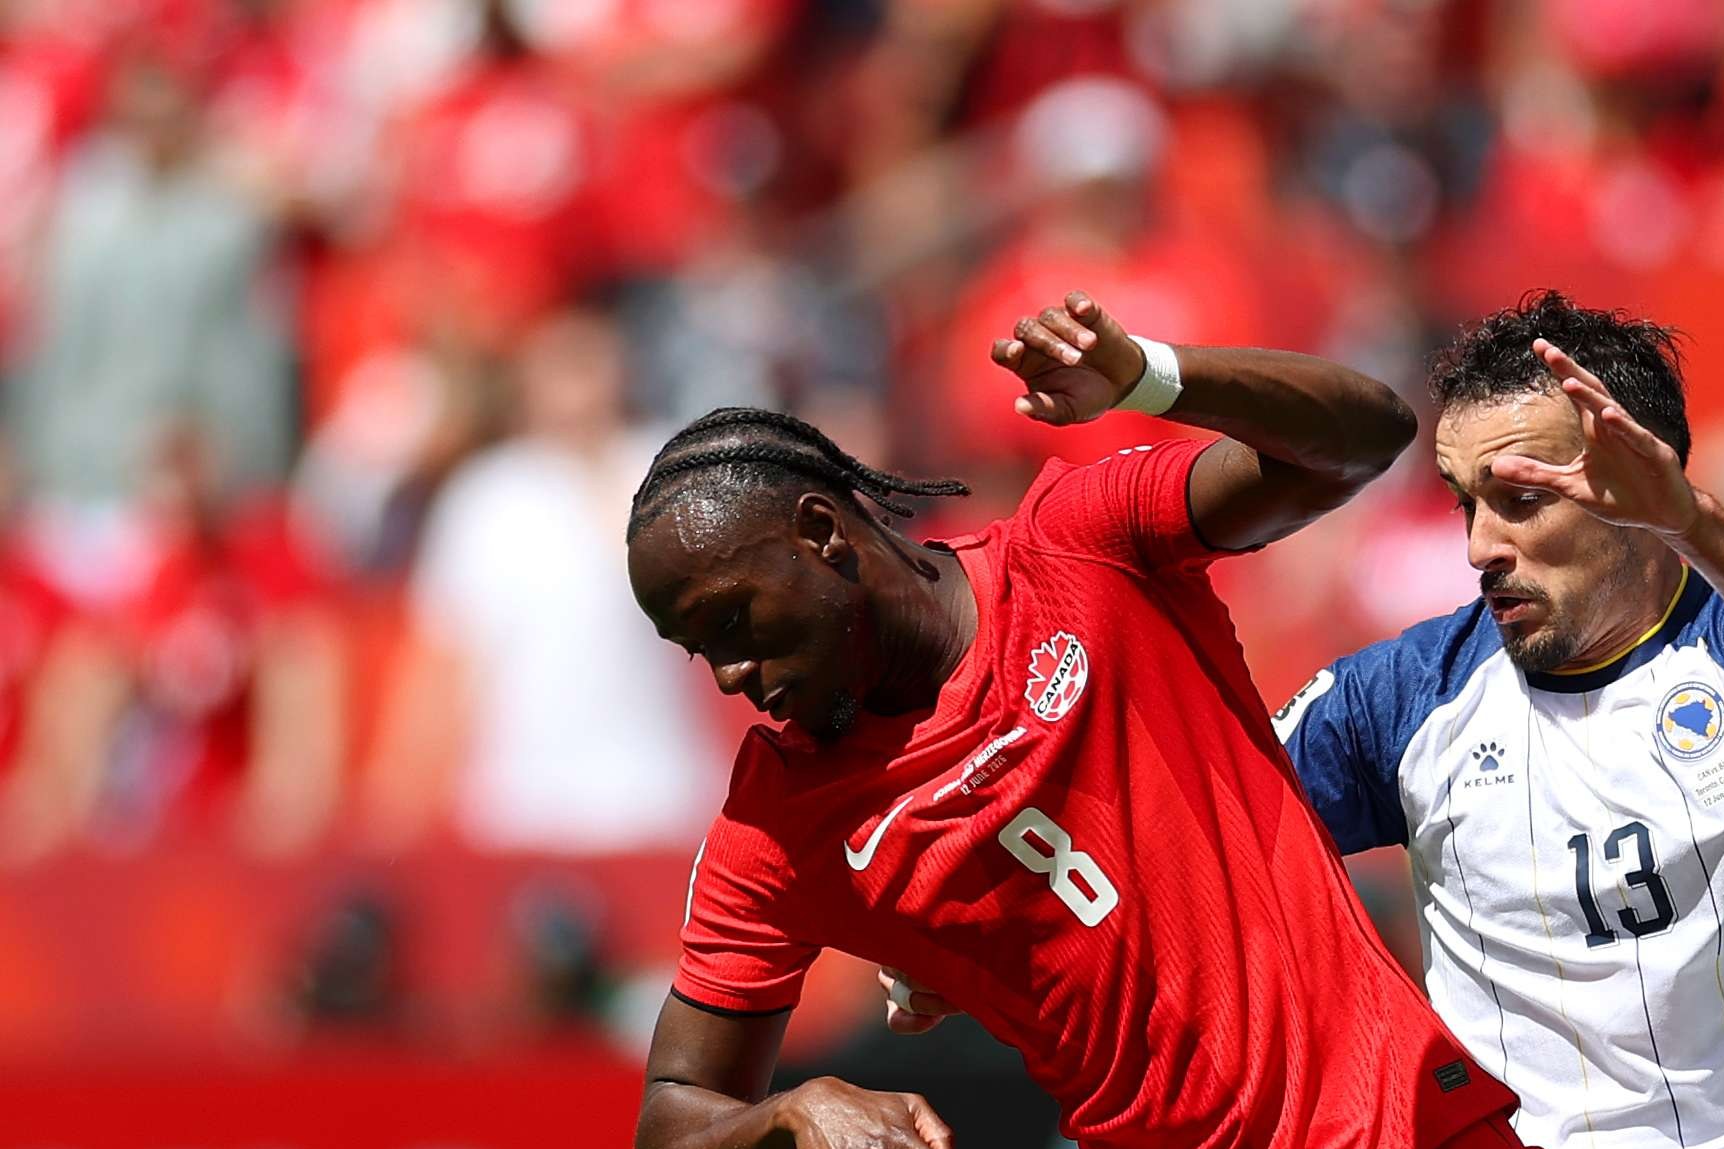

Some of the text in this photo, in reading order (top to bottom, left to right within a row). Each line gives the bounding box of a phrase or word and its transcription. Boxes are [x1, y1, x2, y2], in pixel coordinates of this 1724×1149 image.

[1037, 643, 1078, 714] CANADA
[960, 783, 972, 796] 12
[969, 769, 990, 788] JUNE
[1464, 774, 1515, 788] KELME
[998, 807, 1119, 928] 8
[1567, 820, 1680, 950] 13
